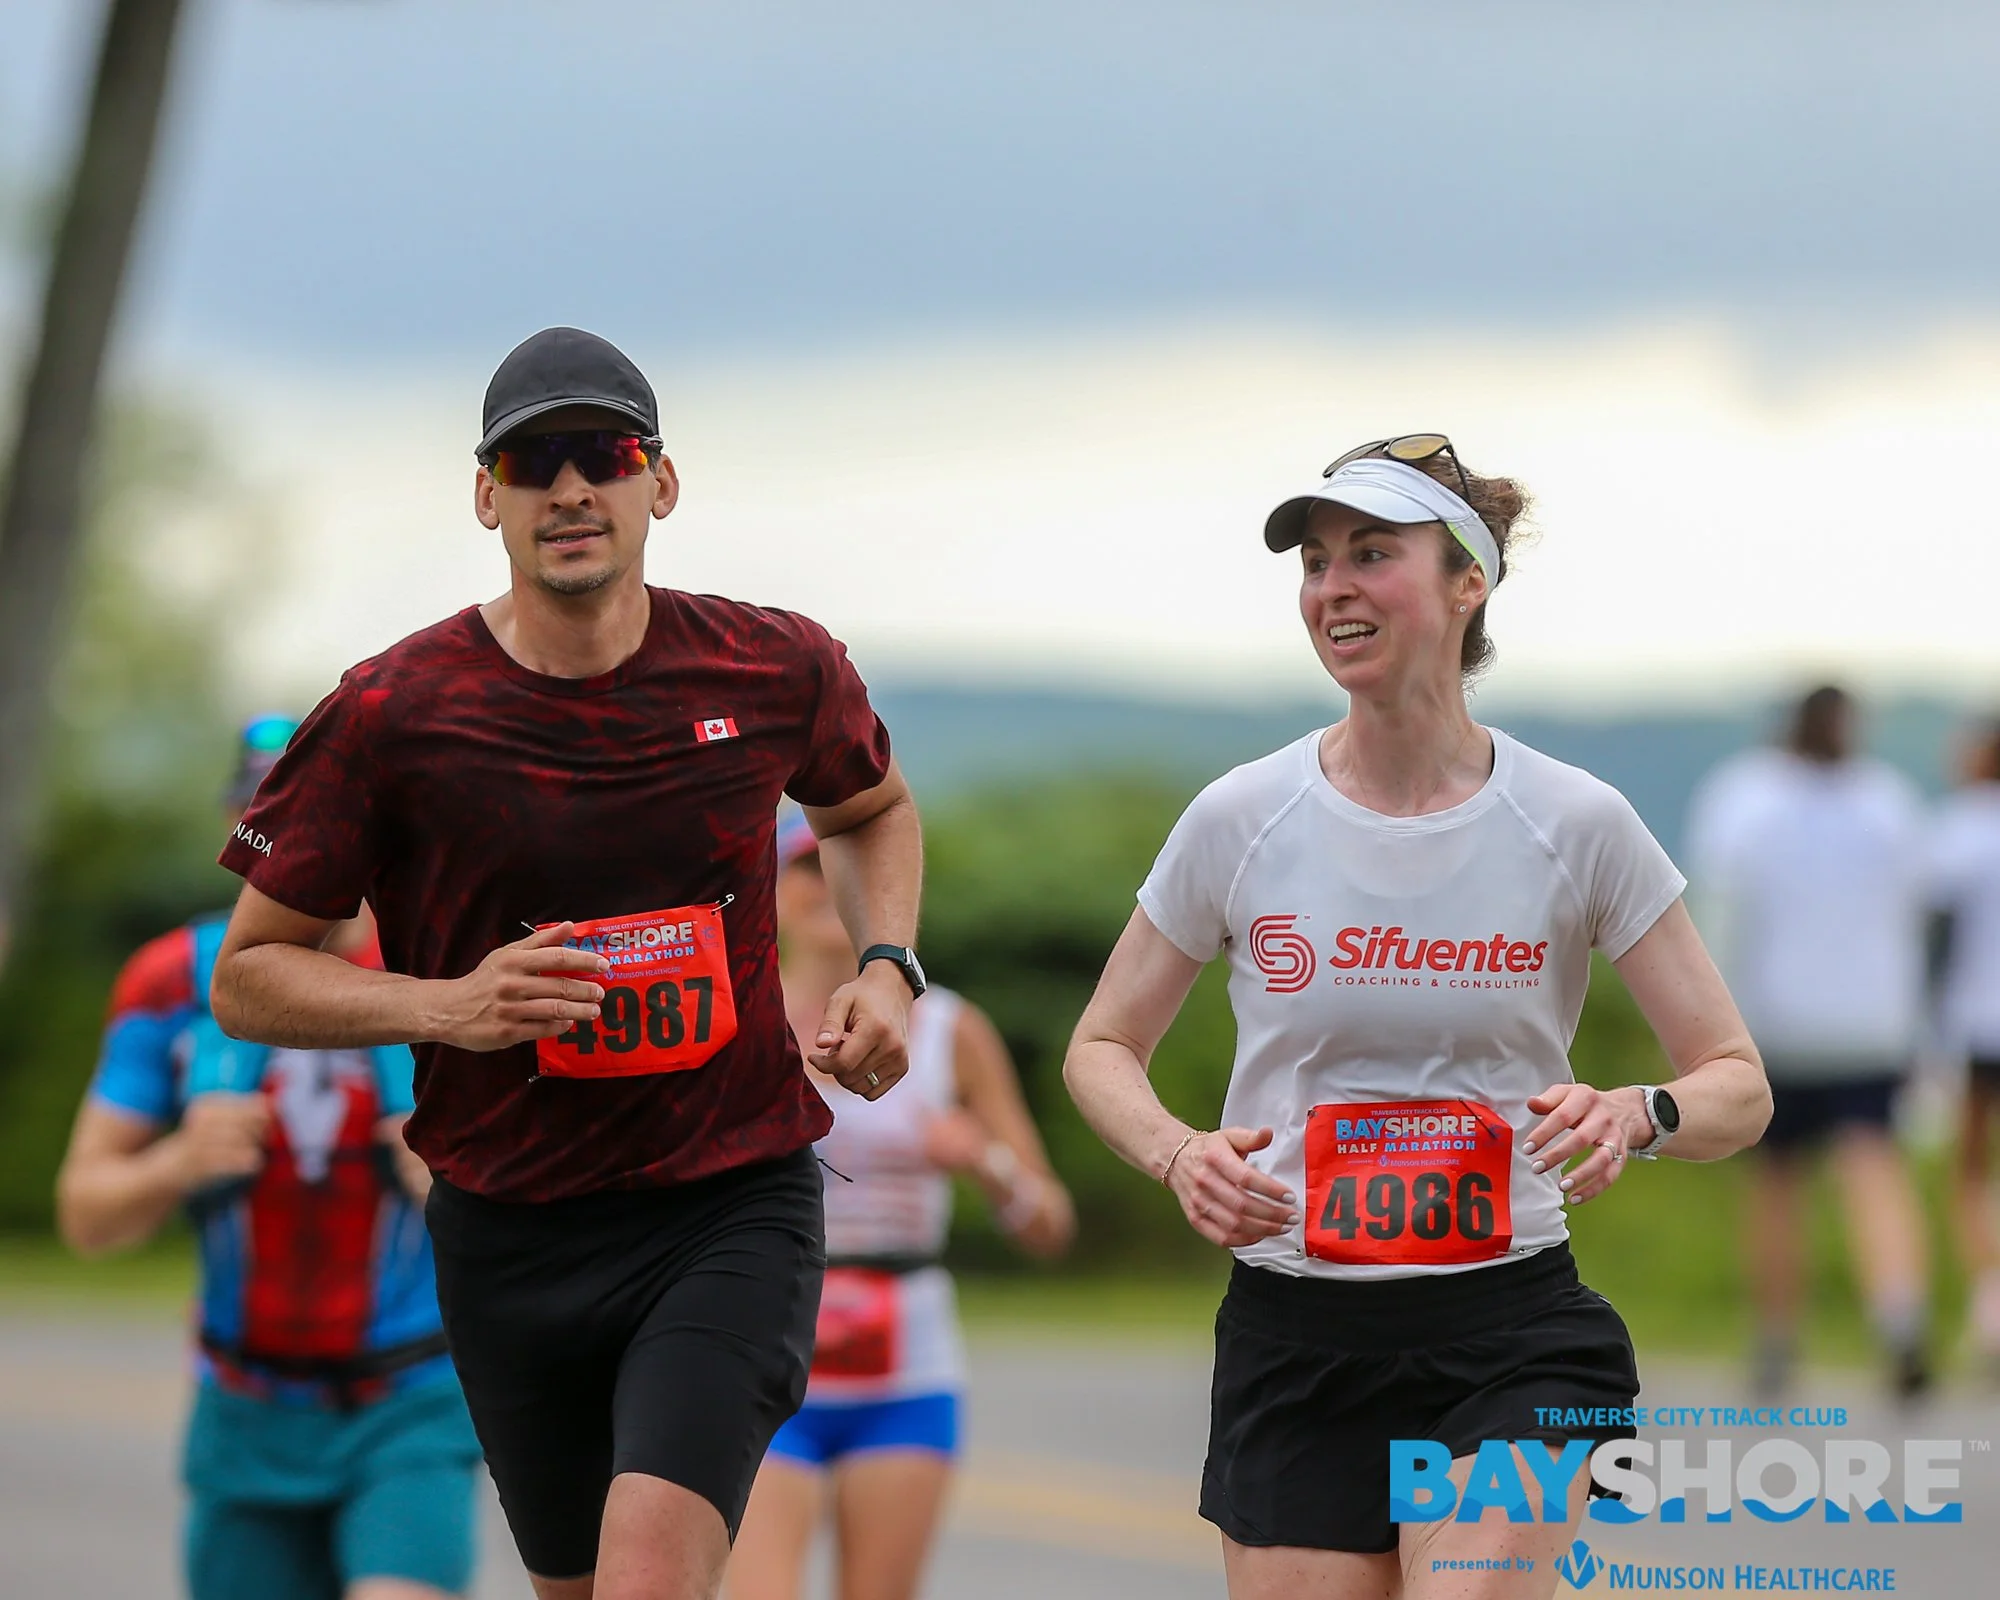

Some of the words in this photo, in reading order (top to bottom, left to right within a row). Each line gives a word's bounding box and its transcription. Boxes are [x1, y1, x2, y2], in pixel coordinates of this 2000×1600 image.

[622, 922, 633, 930] CITY
[634, 920, 650, 928] TRACK
[609, 945, 695, 965] MARATHON
[1329, 926, 1548, 973] Sifuentes
[1334, 976, 1420, 987] COACHING
[1431, 978, 1439, 987] &
[1449, 978, 1540, 989] CONSULTING
[1336, 1115, 1476, 1140] BAYSHORE
[1337, 1143, 1377, 1154] HALF
[1384, 1140, 1476, 1152] MARATHON
[1320, 1172, 1494, 1241] 4986
